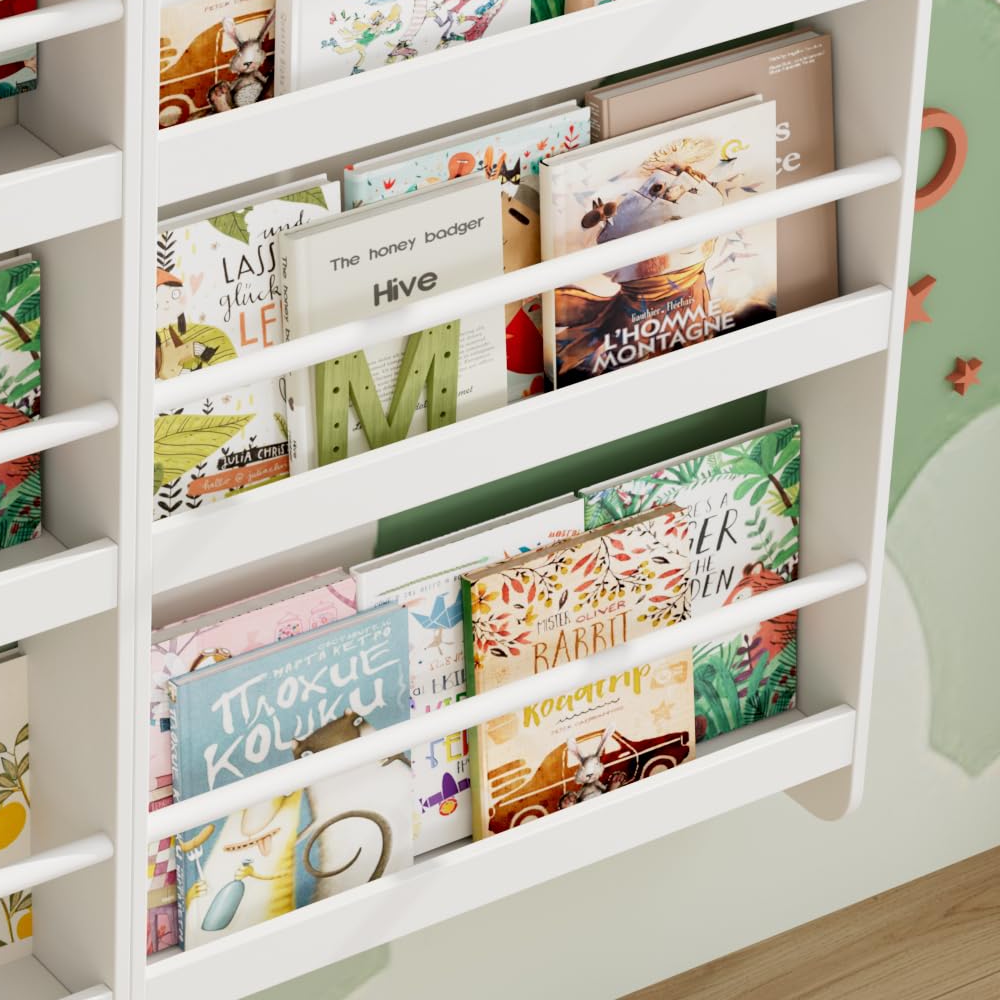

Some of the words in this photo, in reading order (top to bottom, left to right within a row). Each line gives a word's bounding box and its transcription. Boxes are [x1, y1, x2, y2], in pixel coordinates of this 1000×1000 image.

[330, 254, 360, 271] The
[369, 237, 416, 261] honey
[425, 217, 484, 244] badger
[373, 272, 438, 307] Hive
[592, 311, 736, 374] MONTAGNE
[603, 298, 722, 352] L'HOMME
[537, 609, 572, 634] MISTER
[575, 600, 627, 624] OLIVER
